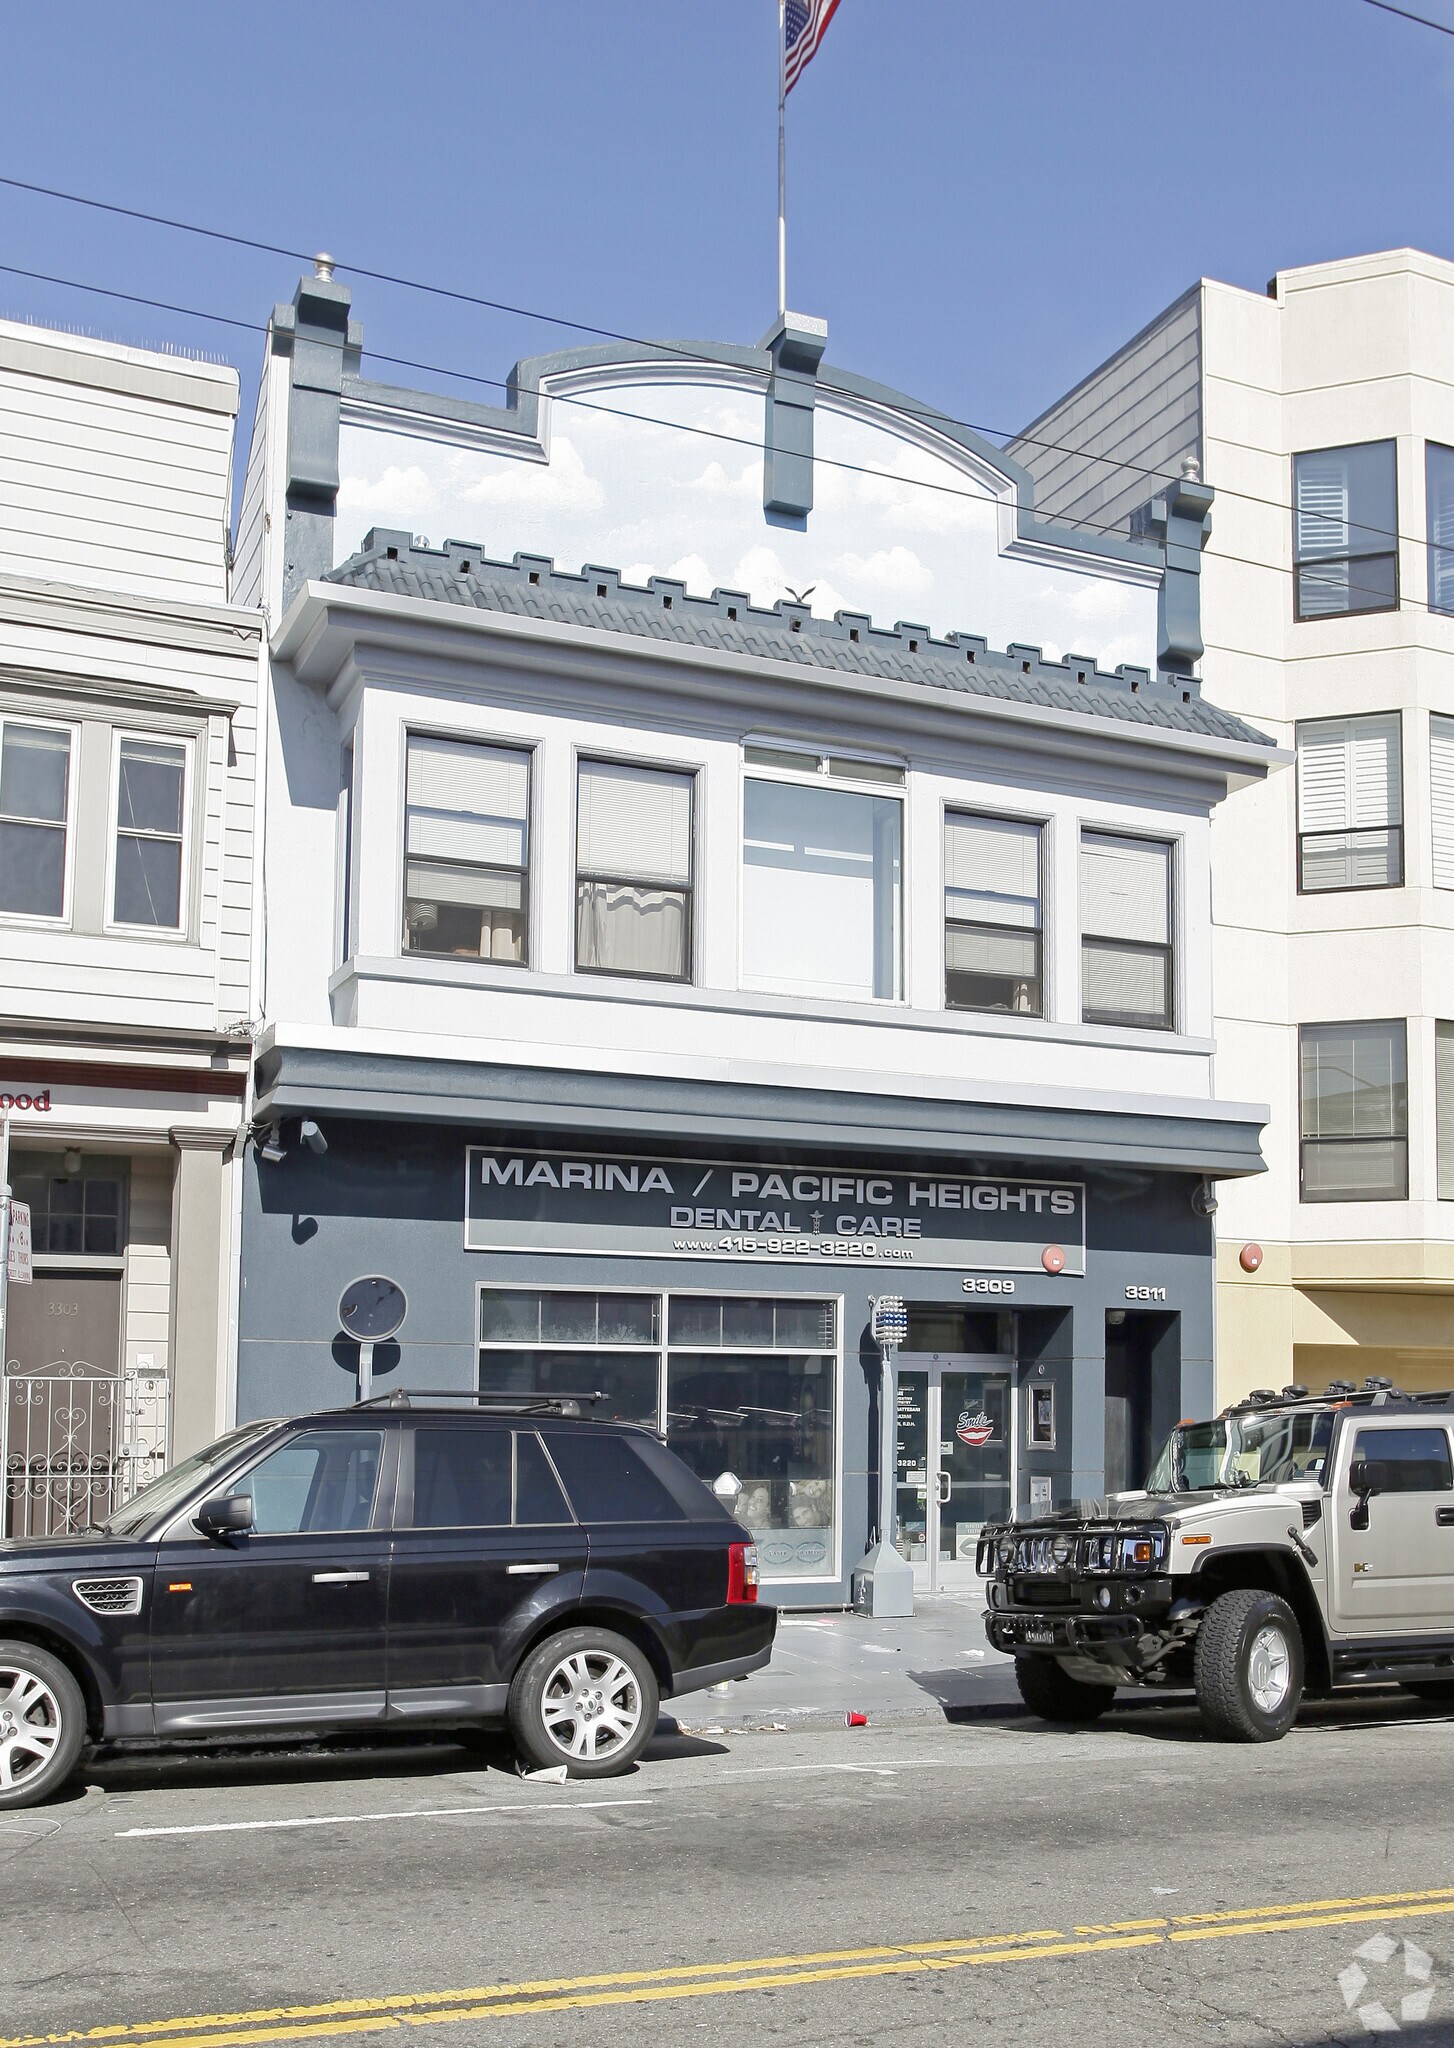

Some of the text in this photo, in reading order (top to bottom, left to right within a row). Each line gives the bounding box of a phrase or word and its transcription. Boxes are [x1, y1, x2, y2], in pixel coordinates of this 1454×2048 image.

[481, 1157, 1075, 1215] MARINA / PACIFIC HEIGHTS
[12, 1208, 30, 1227] PARKING
[670, 1206, 922, 1238] DENTAL CARE
[962, 1278, 1015, 1294] 3309
[1125, 1285, 1167, 1301] 3311
[46, 1302, 79, 1317] 3303
[956, 1411, 994, 1429] Smile
[897, 1459, 917, 1467] 3220
